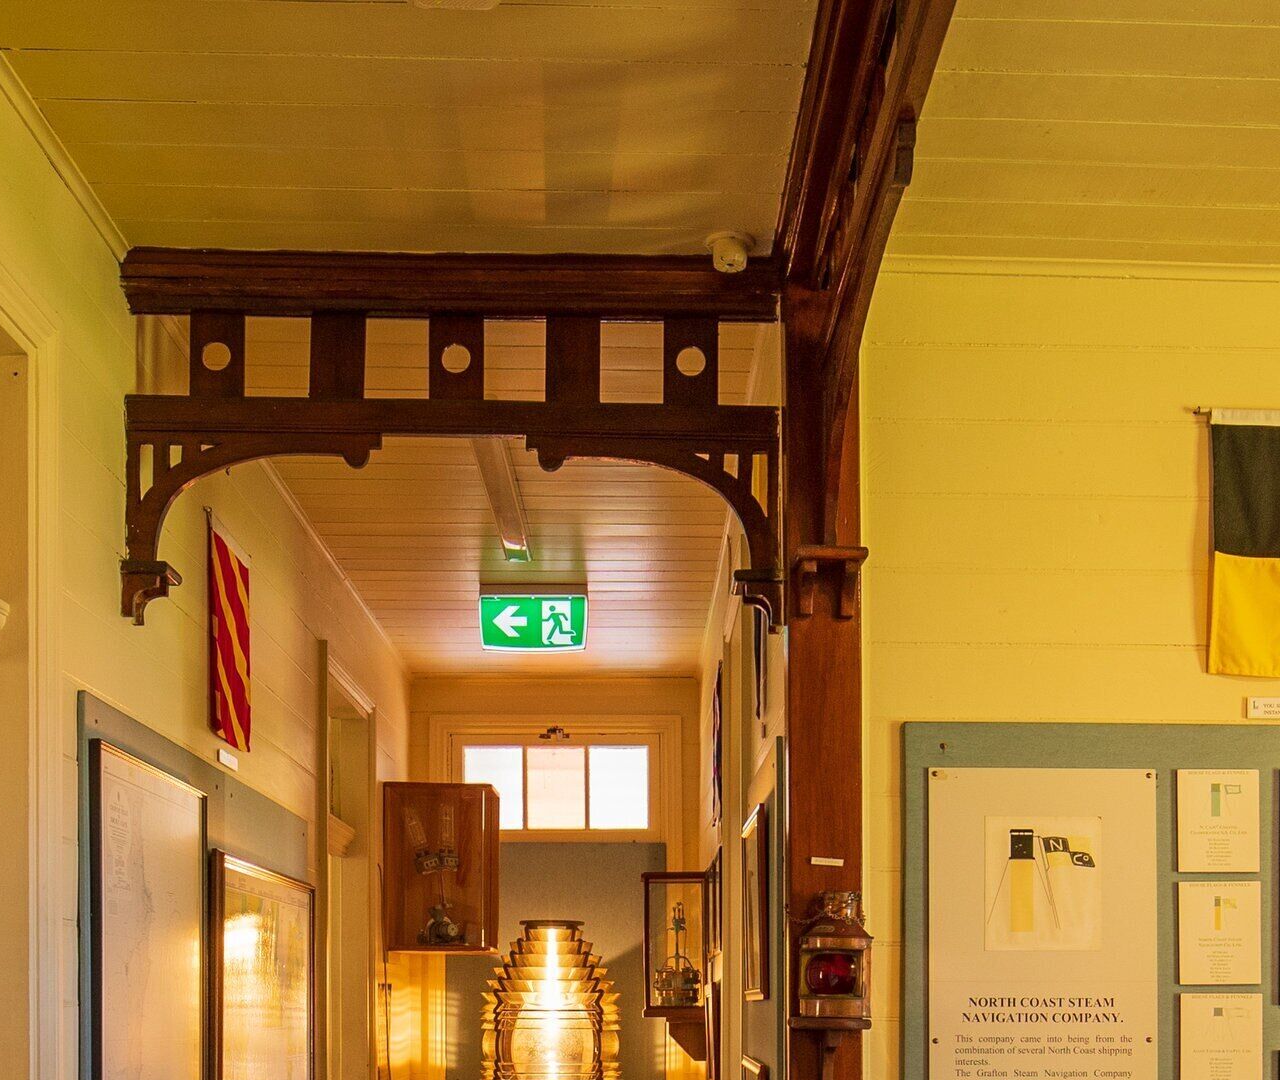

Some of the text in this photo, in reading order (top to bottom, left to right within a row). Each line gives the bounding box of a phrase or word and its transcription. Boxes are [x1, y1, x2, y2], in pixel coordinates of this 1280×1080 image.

[1253, 701, 1258, 709] L
[1050, 839, 1063, 852] N
[968, 997, 1115, 1008] NORTH COAST STEAM
[962, 1012, 1124, 1023] NAVIGATION COMPANY.
[955, 1034, 974, 1043] This
[978, 1036, 1016, 1045] company
[1046, 1034, 1063, 1043] into
[1067, 1034, 1090, 1045] being
[1095, 1034, 1115, 1043] from
[1120, 1034, 1133, 1043] the
[955, 1046, 1133, 1057] combination of several North Coast shipping
[955, 1057, 991, 1066] interests.
[955, 1069, 1133, 1080] The Grafton Steam Navigation Company
